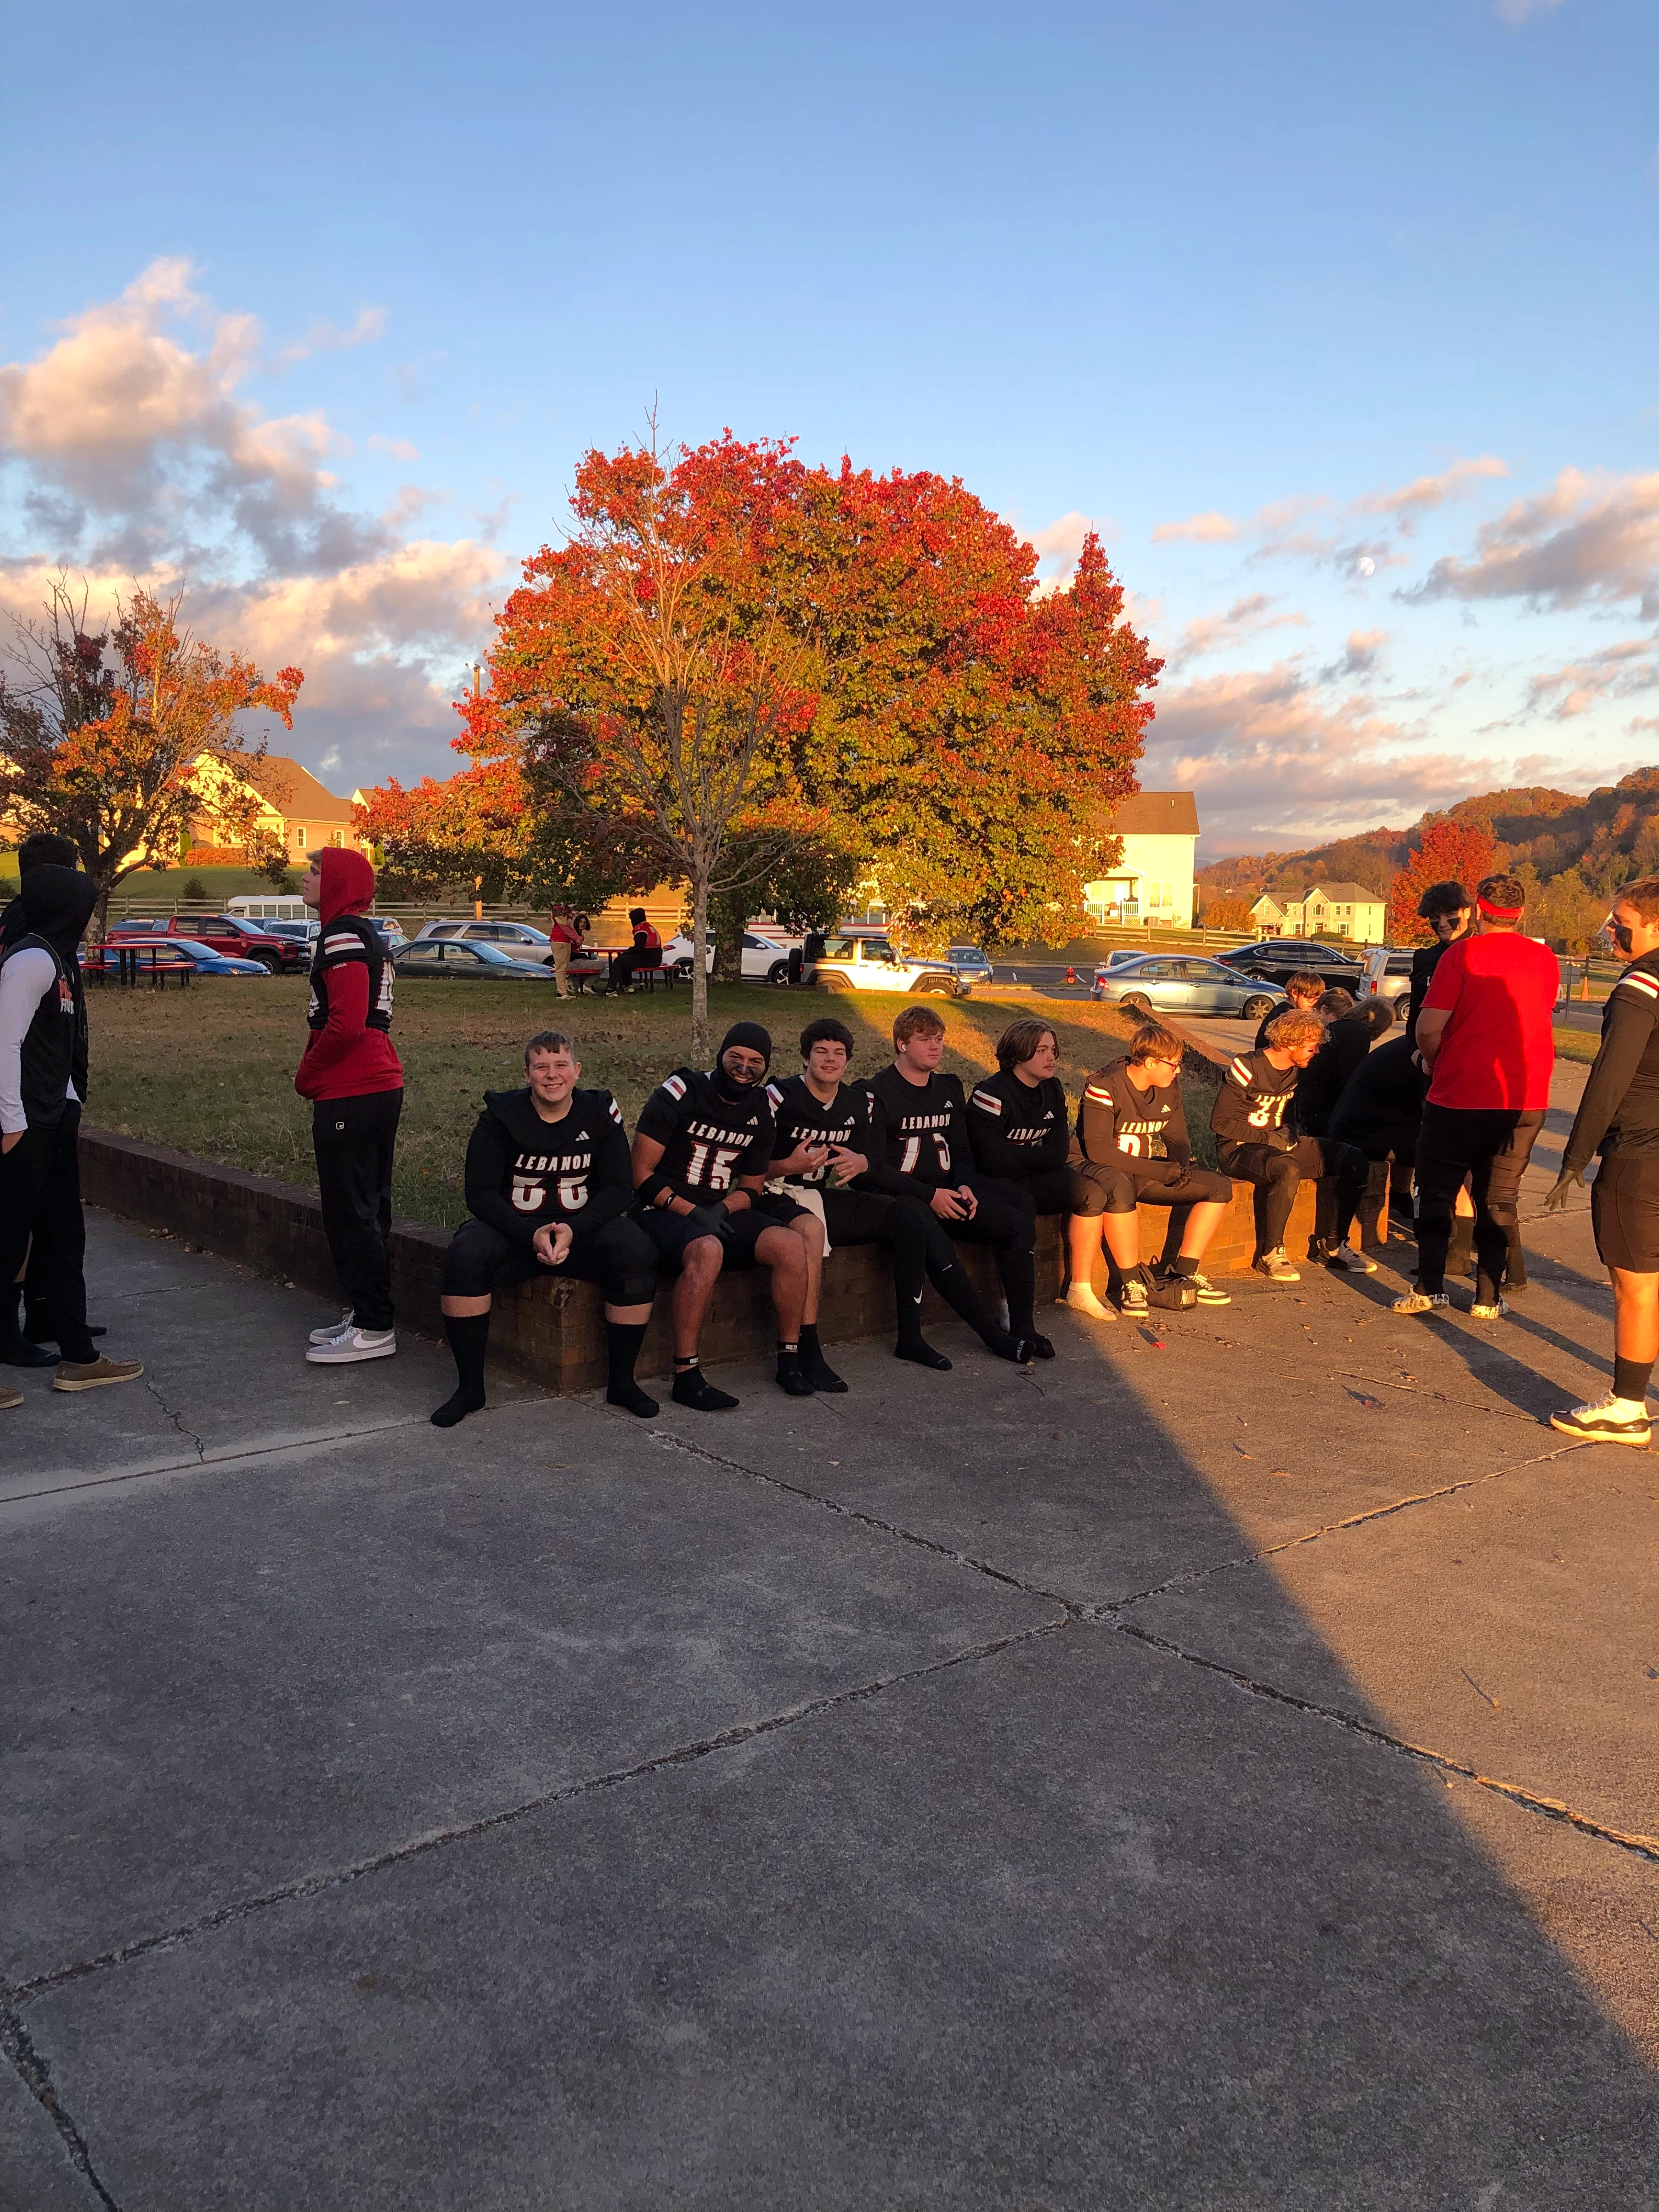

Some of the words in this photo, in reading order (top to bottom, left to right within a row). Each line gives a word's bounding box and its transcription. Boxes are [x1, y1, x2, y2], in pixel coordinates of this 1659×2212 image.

[901, 1113, 951, 1130] LEBANON
[687, 1121, 754, 1147] LEBANON
[790, 1126, 851, 1142] LEBANON
[515, 1153, 591, 1171] LEBANON
[686, 1141, 742, 1190] 15
